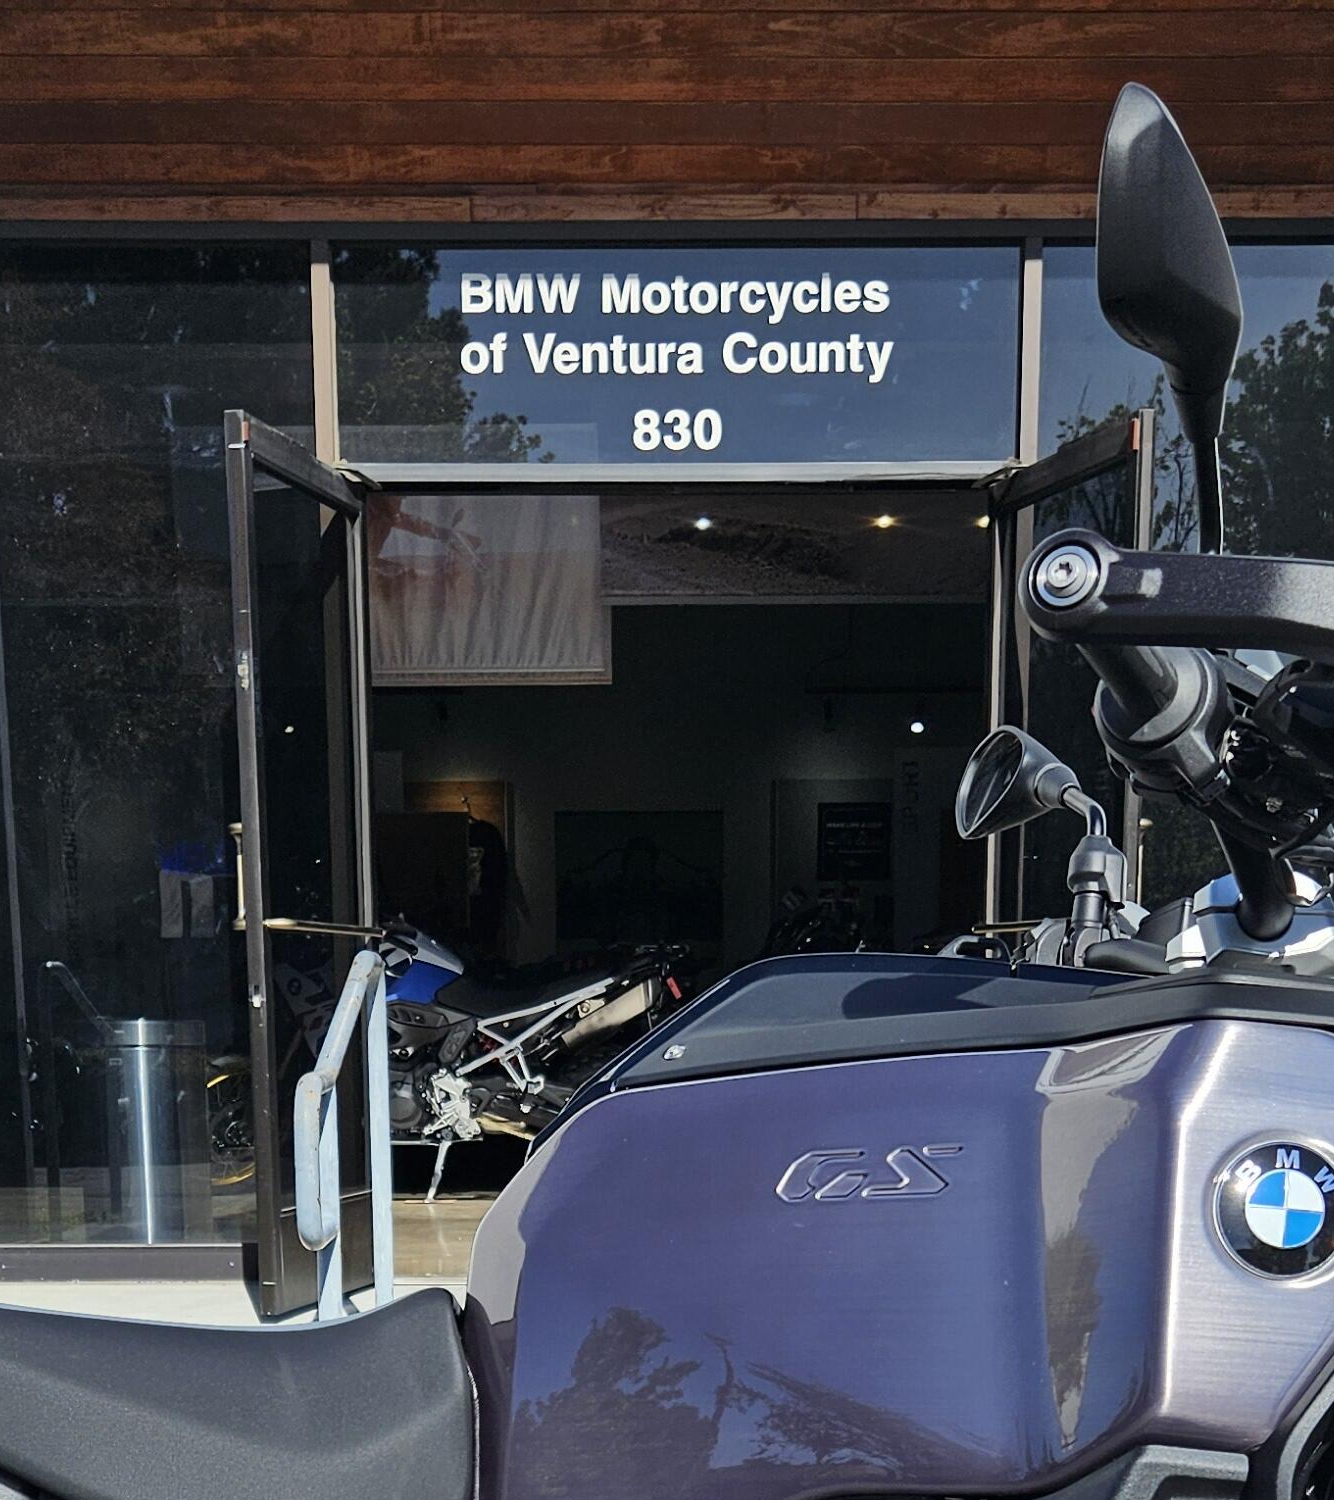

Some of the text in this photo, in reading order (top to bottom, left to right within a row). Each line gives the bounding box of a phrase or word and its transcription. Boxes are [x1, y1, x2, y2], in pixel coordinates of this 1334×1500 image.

[461, 273, 890, 325] BMW Motorcycles
[460, 332, 894, 383] of Ventura County
[632, 409, 723, 452] 830
[775, 1144, 964, 1203] GS
